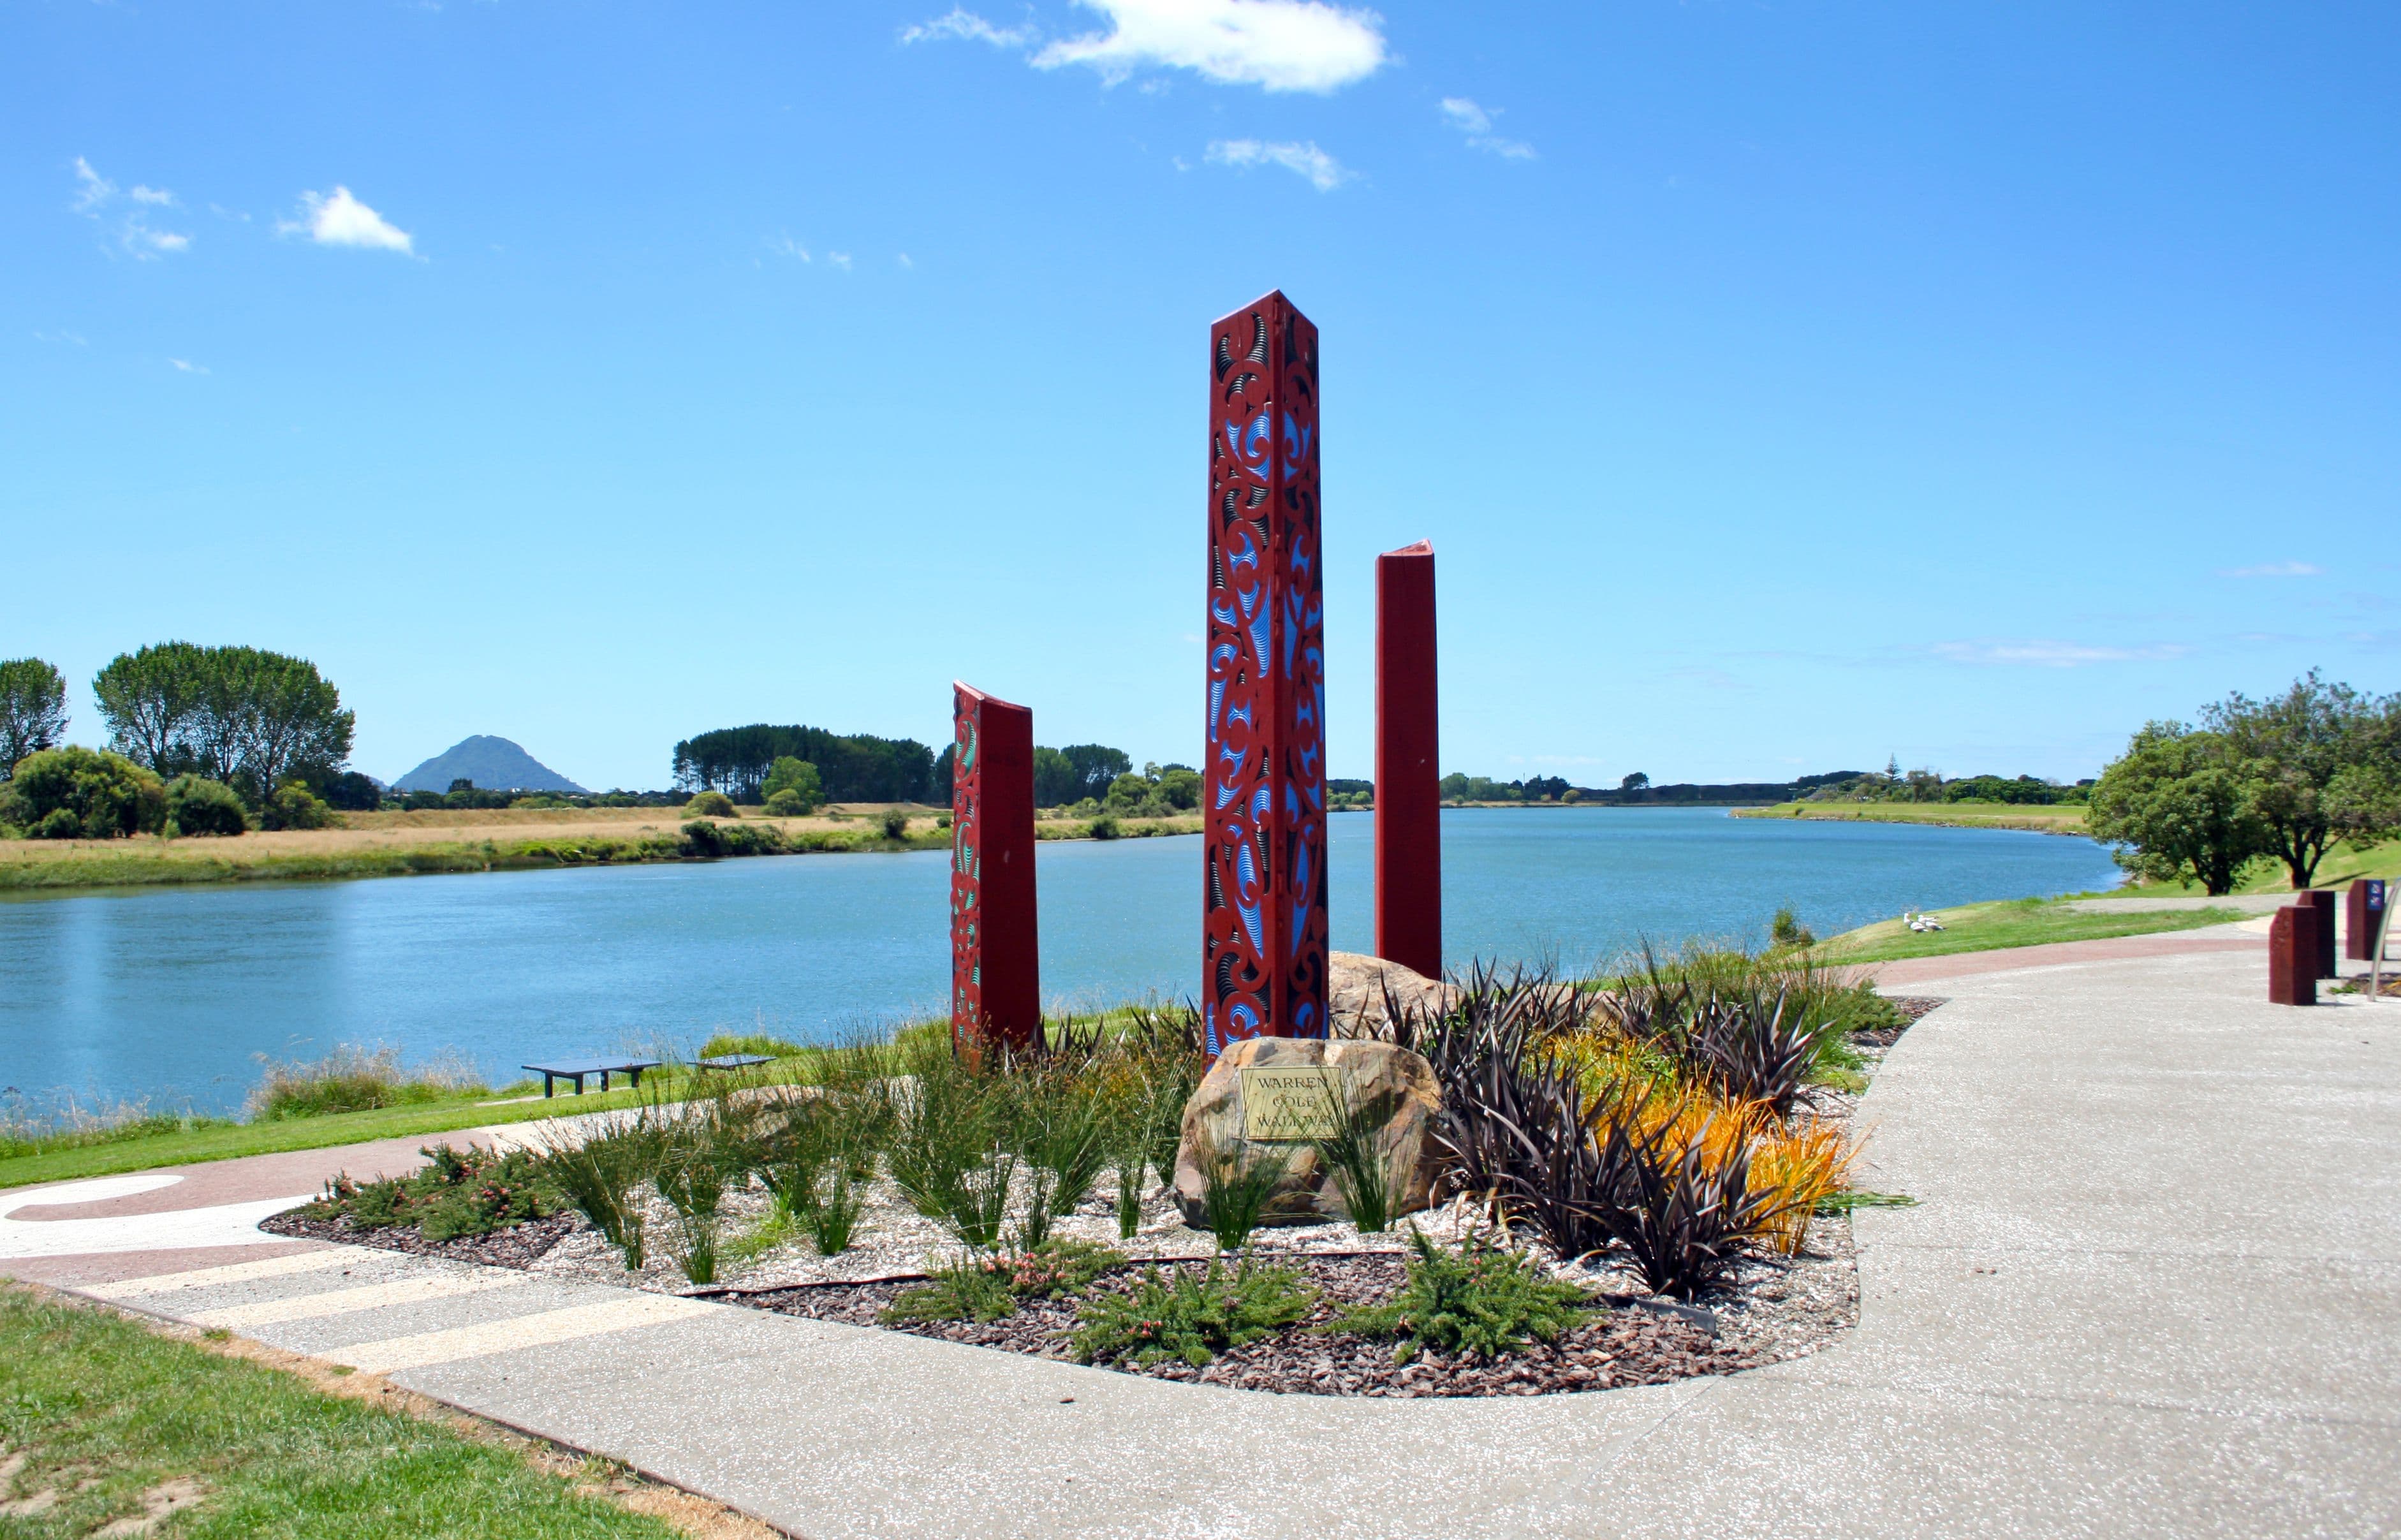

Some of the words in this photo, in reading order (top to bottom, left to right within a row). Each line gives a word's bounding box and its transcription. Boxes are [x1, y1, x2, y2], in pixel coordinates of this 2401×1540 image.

[1258, 1077, 1328, 1089] WARREN
[1272, 1096, 1316, 1108] COLE
[1257, 1116, 1334, 1127] WALWA
